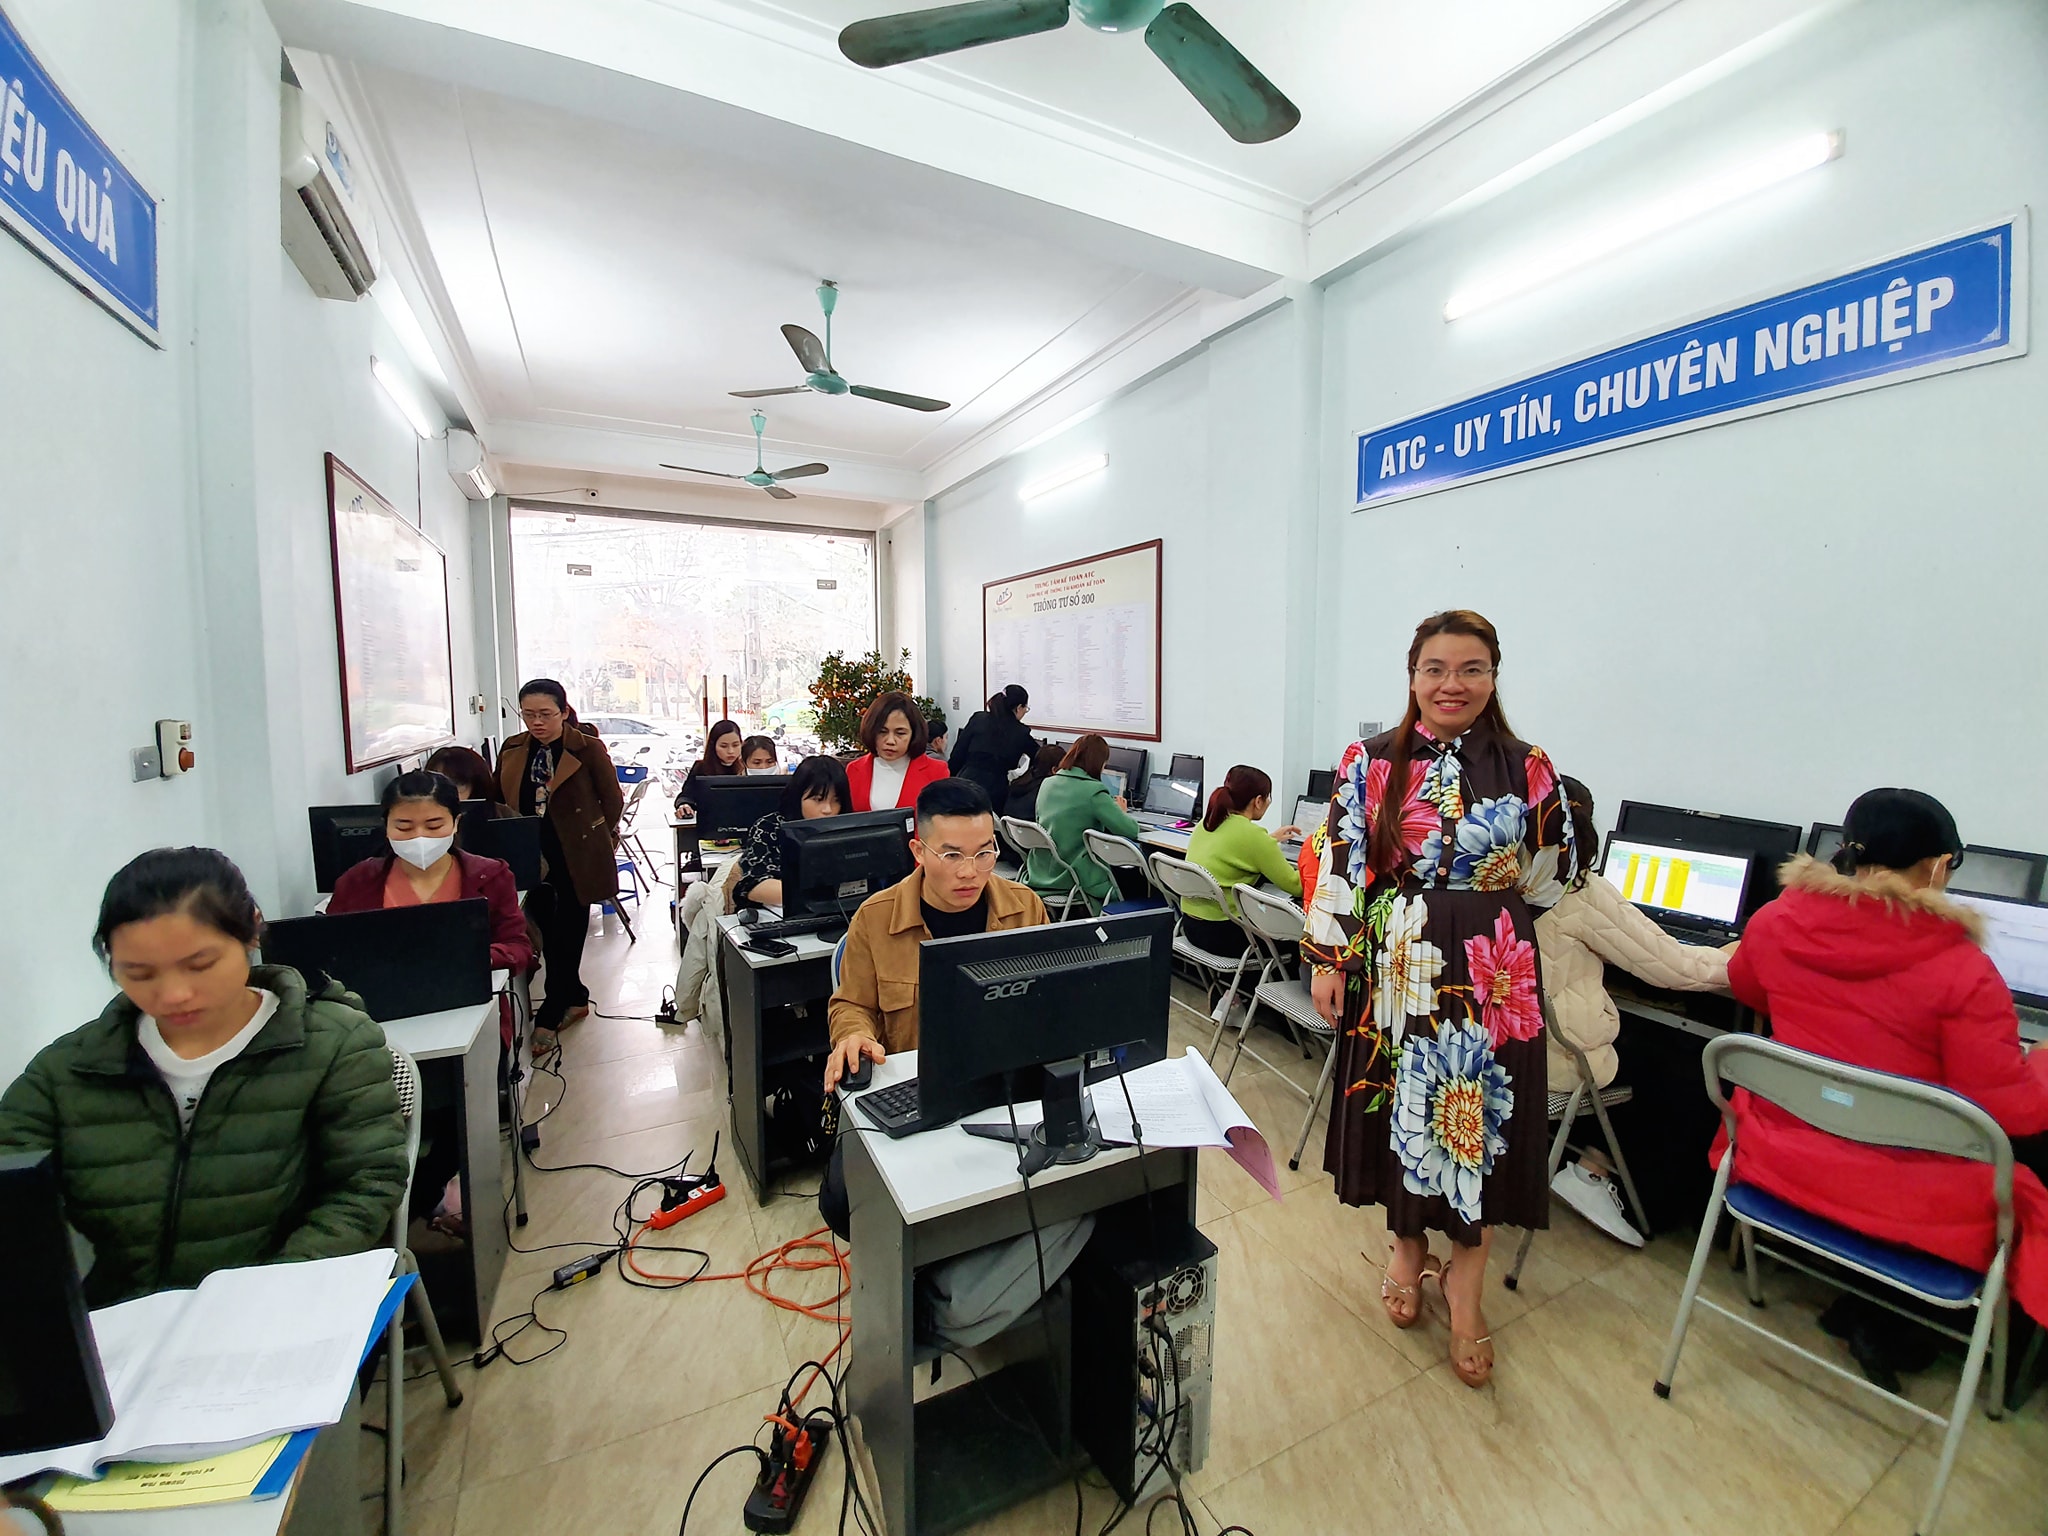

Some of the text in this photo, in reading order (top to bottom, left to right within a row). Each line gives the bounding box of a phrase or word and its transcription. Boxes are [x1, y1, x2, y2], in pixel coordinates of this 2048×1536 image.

[55, 148, 118, 266] QUẢ
[1379, 434, 1427, 480] ATC
[1452, 414, 1492, 459] UY
[1499, 392, 1562, 441] TÍN,
[1573, 335, 1738, 424] CHUYÊN
[1753, 276, 1956, 377] NGHIỆP
[1081, 592, 1095, 605] 200
[341, 827, 376, 837] acer
[984, 979, 1036, 1001] acer
